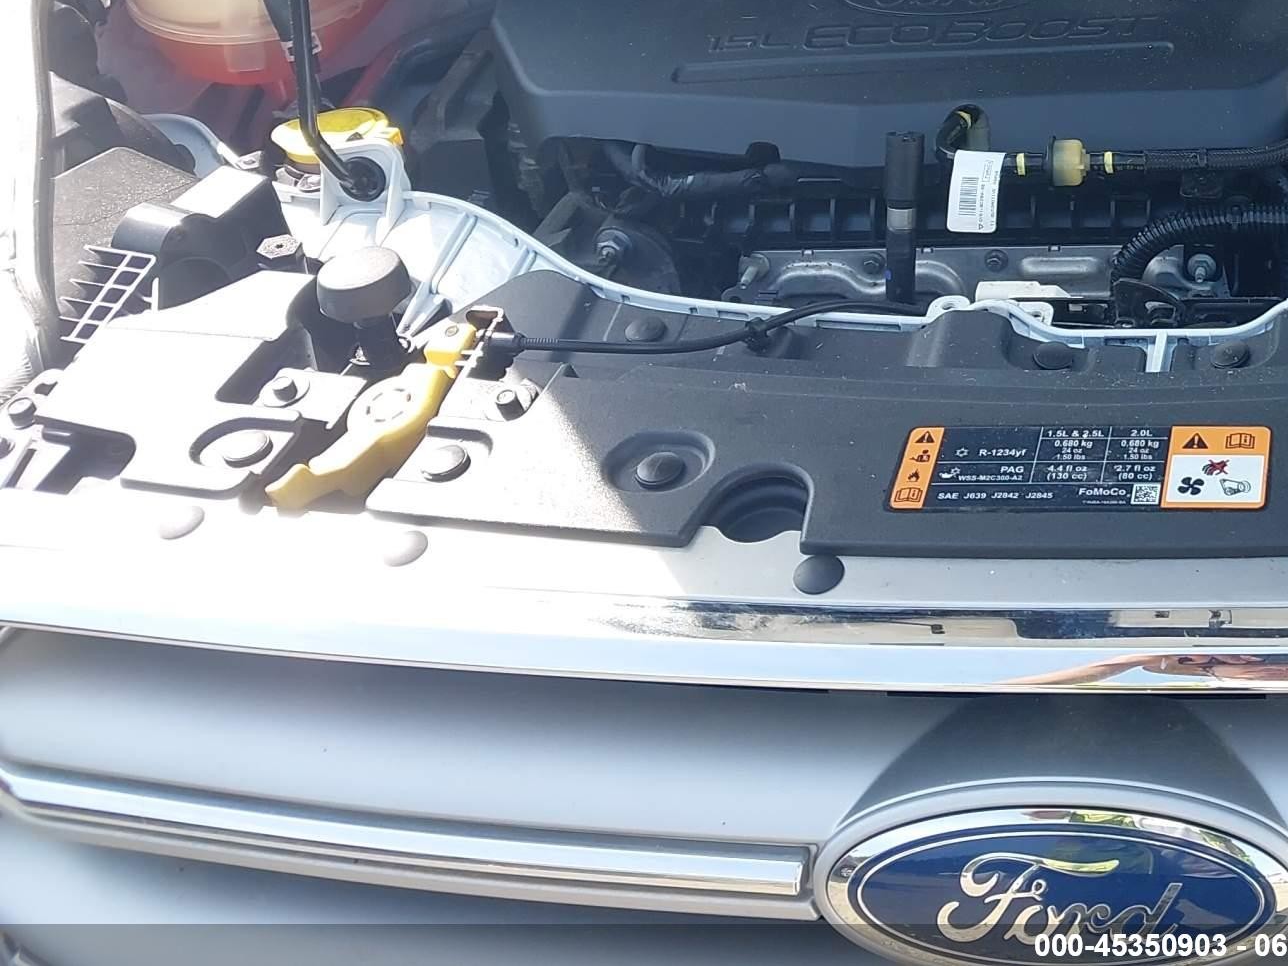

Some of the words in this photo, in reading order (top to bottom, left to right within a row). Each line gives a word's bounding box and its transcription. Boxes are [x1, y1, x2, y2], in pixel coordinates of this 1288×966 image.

[803, 16, 1158, 50] ECOBOOST
[1130, 429, 1153, 437] 2.0L
[1054, 439, 1079, 447] 0.680
[1080, 439, 1093, 448] kg
[1120, 439, 1145, 447] 0.680
[1147, 439, 1160, 448] kg
[978, 448, 1027, 458] R-1234yf
[1046, 472, 1069, 481] (130
[1071, 472, 1088, 481] cc)
[1118, 472, 1135, 480] (80
[1136, 472, 1153, 480] cc)
[937, 492, 959, 500] SAE
[963, 492, 987, 500] J639
[991, 492, 1019, 500] J2842
[1025, 492, 1054, 500] J2845
[937, 851, 1183, 945] Ford
